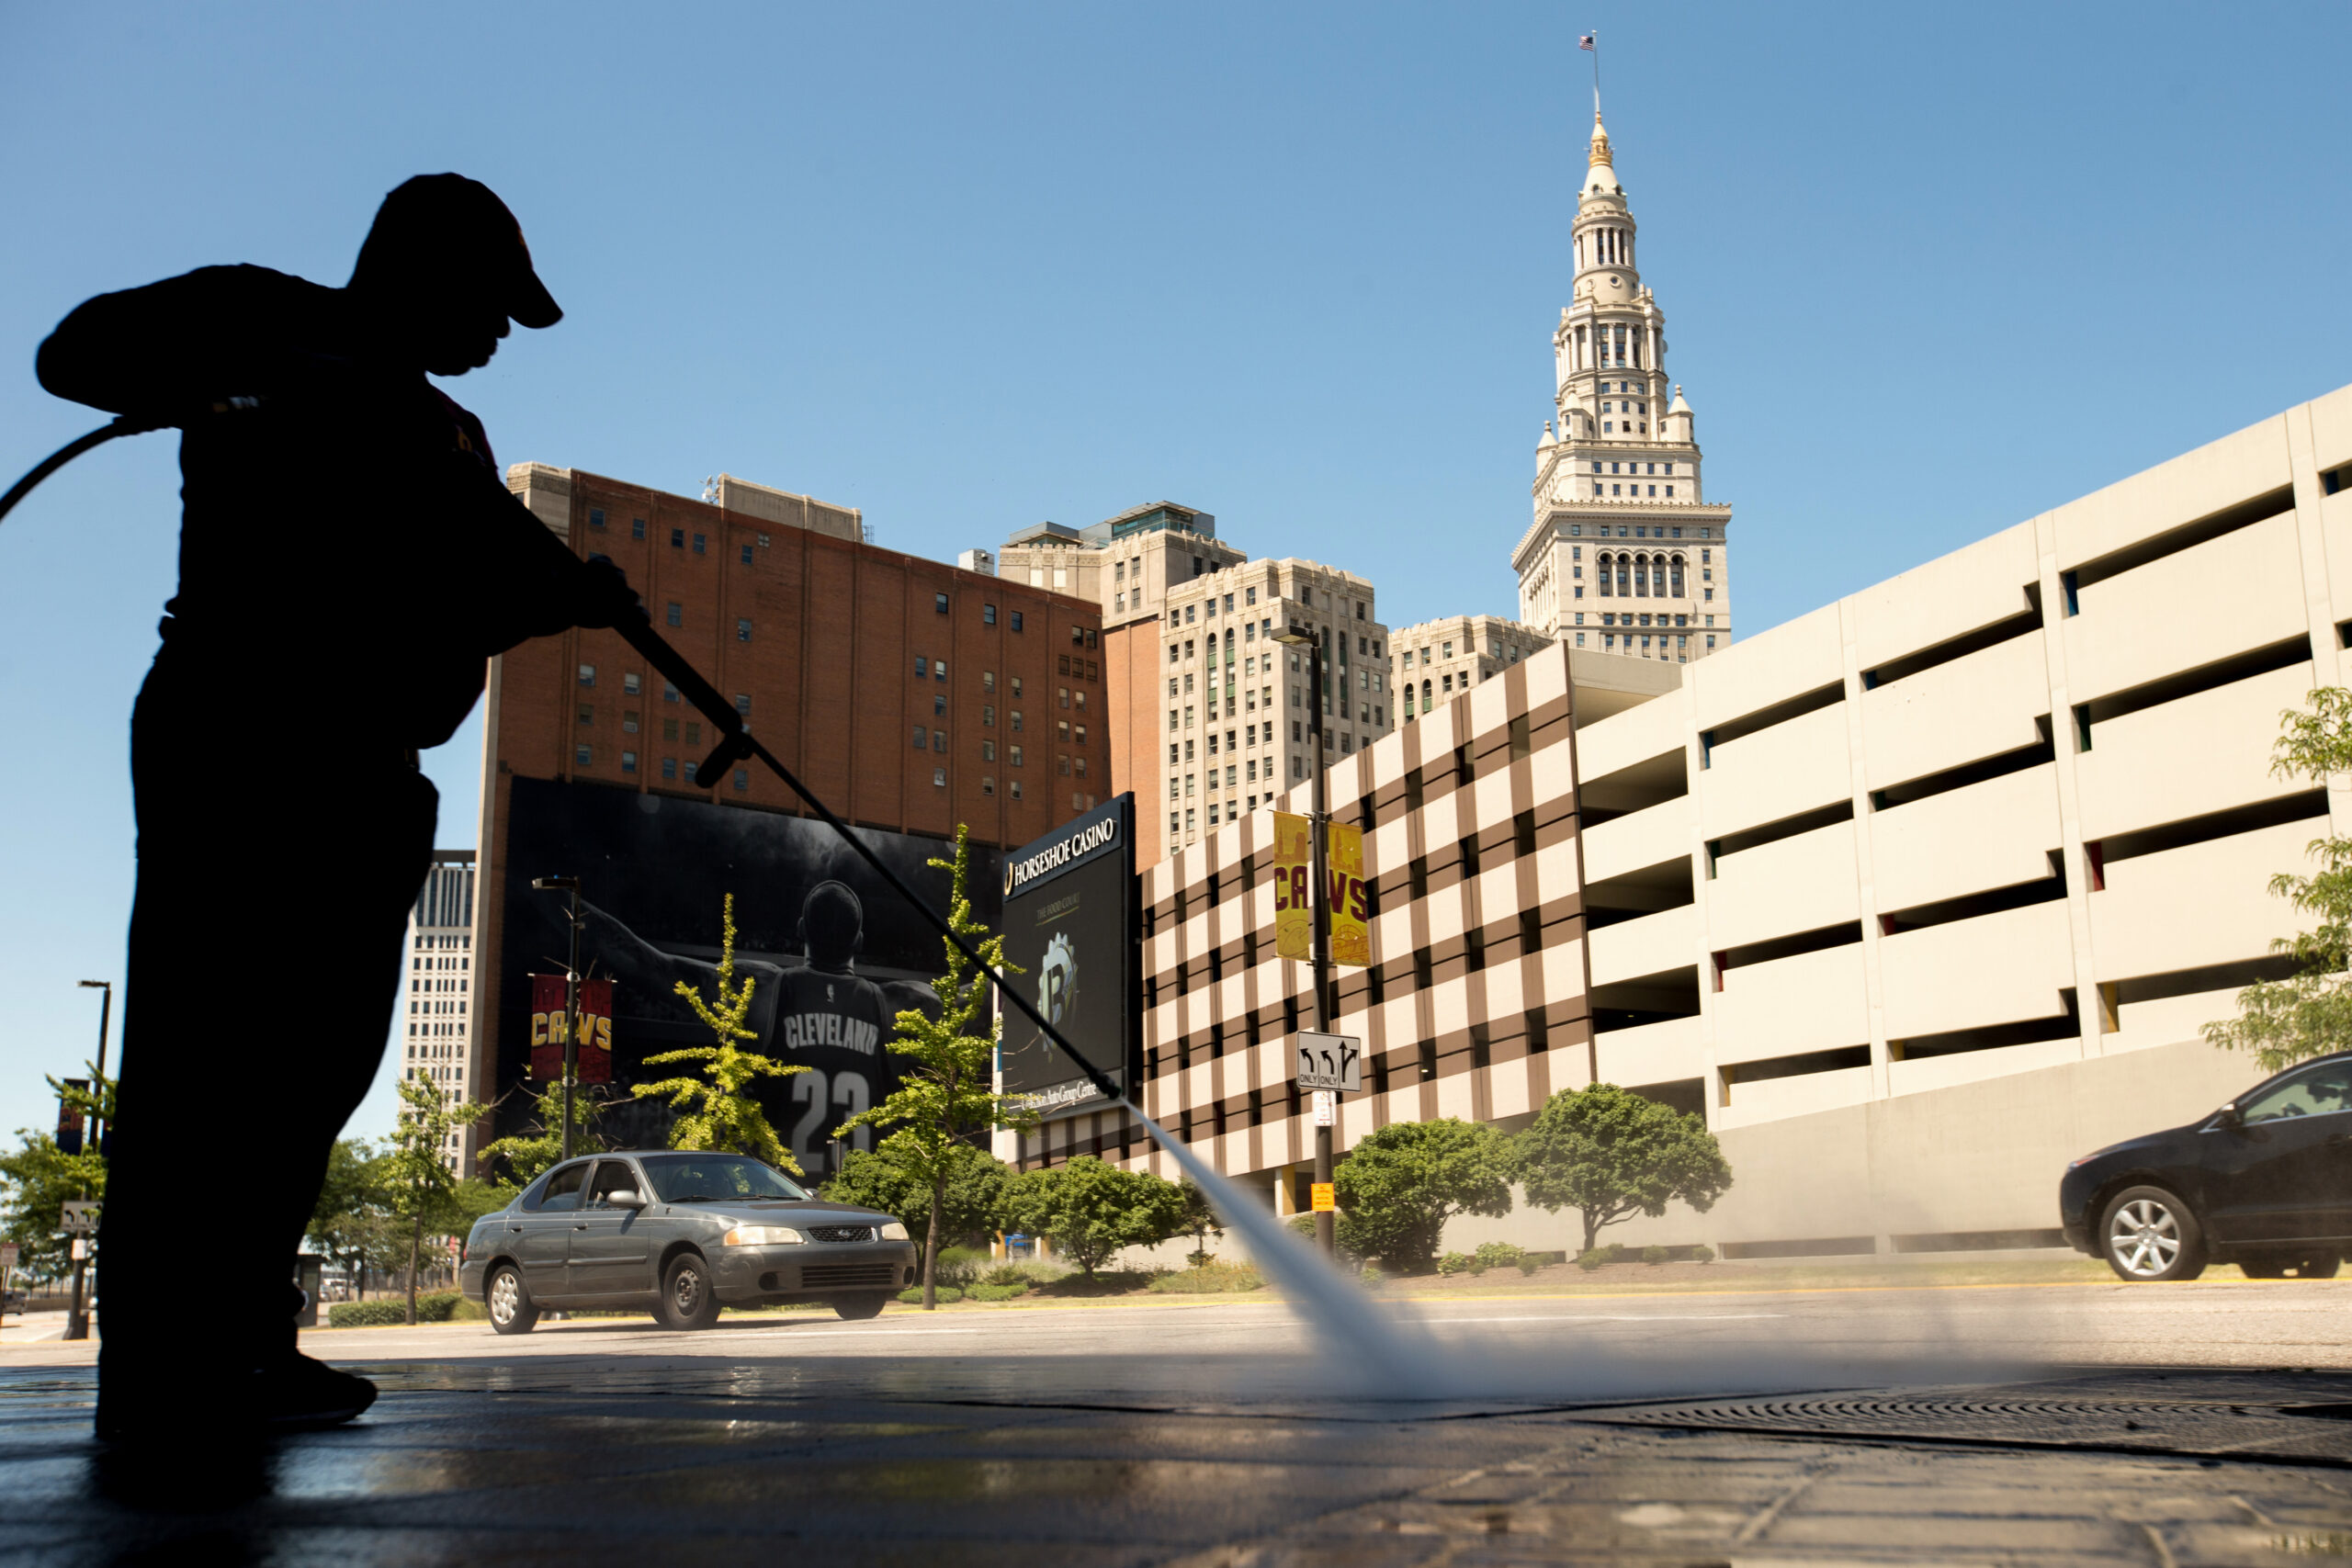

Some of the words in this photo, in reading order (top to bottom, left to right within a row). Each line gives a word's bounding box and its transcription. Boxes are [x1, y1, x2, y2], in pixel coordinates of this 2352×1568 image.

[1014, 840, 1070, 886] HORSESHOE
[1071, 818, 1114, 856] CASINO
[531, 1010, 612, 1051] CAVS
[784, 1013, 878, 1055] CLEVELAND
[1059, 1086, 1077, 1106] Group
[1077, 1081, 1097, 1099] Centre
[1300, 1074, 1317, 1084] ONLY
[1320, 1076, 1338, 1085] ONLY
[791, 1068, 870, 1173] 23
